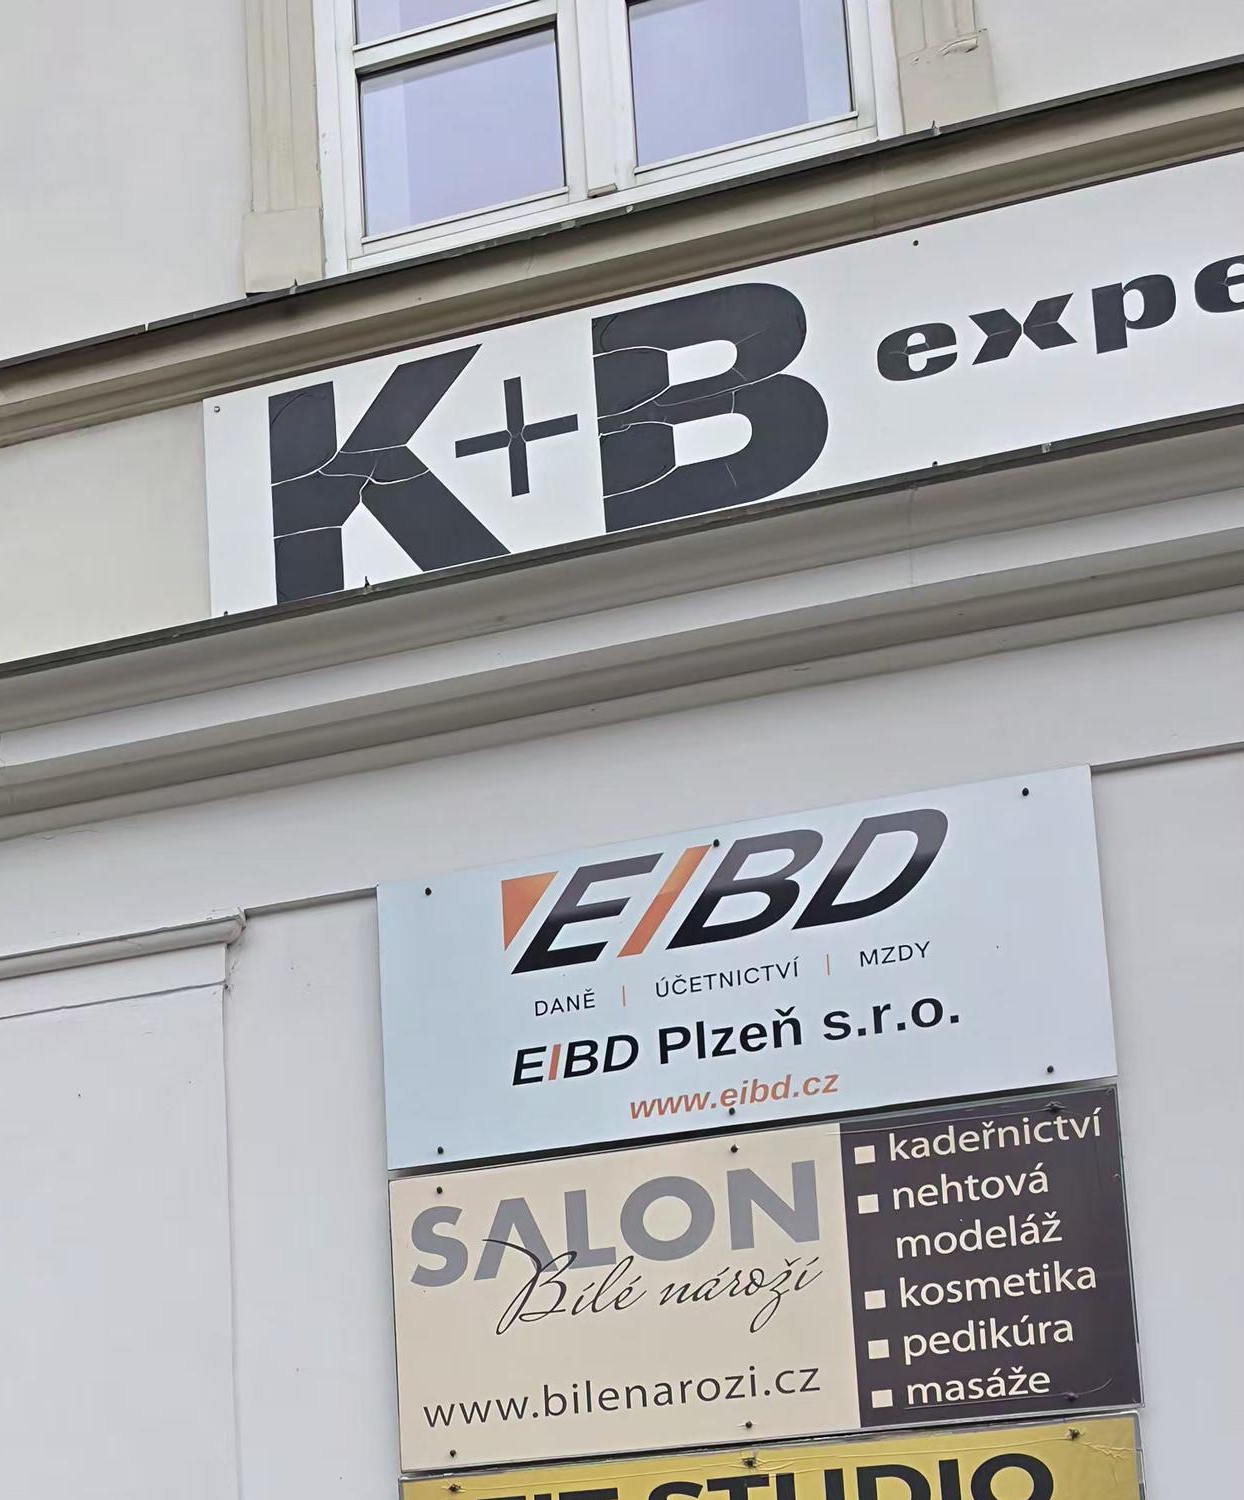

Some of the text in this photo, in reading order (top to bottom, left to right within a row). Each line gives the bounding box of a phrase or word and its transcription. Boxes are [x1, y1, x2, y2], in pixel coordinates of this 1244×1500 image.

[535, 940, 930, 1016] DANĚ ÚČETNICTVÍ MZDY
[512, 996, 960, 1086] EIBD Plzeň s.r.o.
[630, 1071, 840, 1119] www.eibd.cz
[888, 1108, 1102, 1162] kadeřnictví
[892, 1164, 1048, 1210] nehtová
[410, 1160, 820, 1287] SALON
[895, 1212, 1062, 1259] modeláž
[483, 1238, 822, 1335] Bílé nároží
[898, 1261, 1097, 1308] kosmetika
[904, 1314, 1074, 1364] pedikúra
[423, 1365, 821, 1428] www.bilenarozi.cz
[907, 1367, 1051, 1404] masáže
